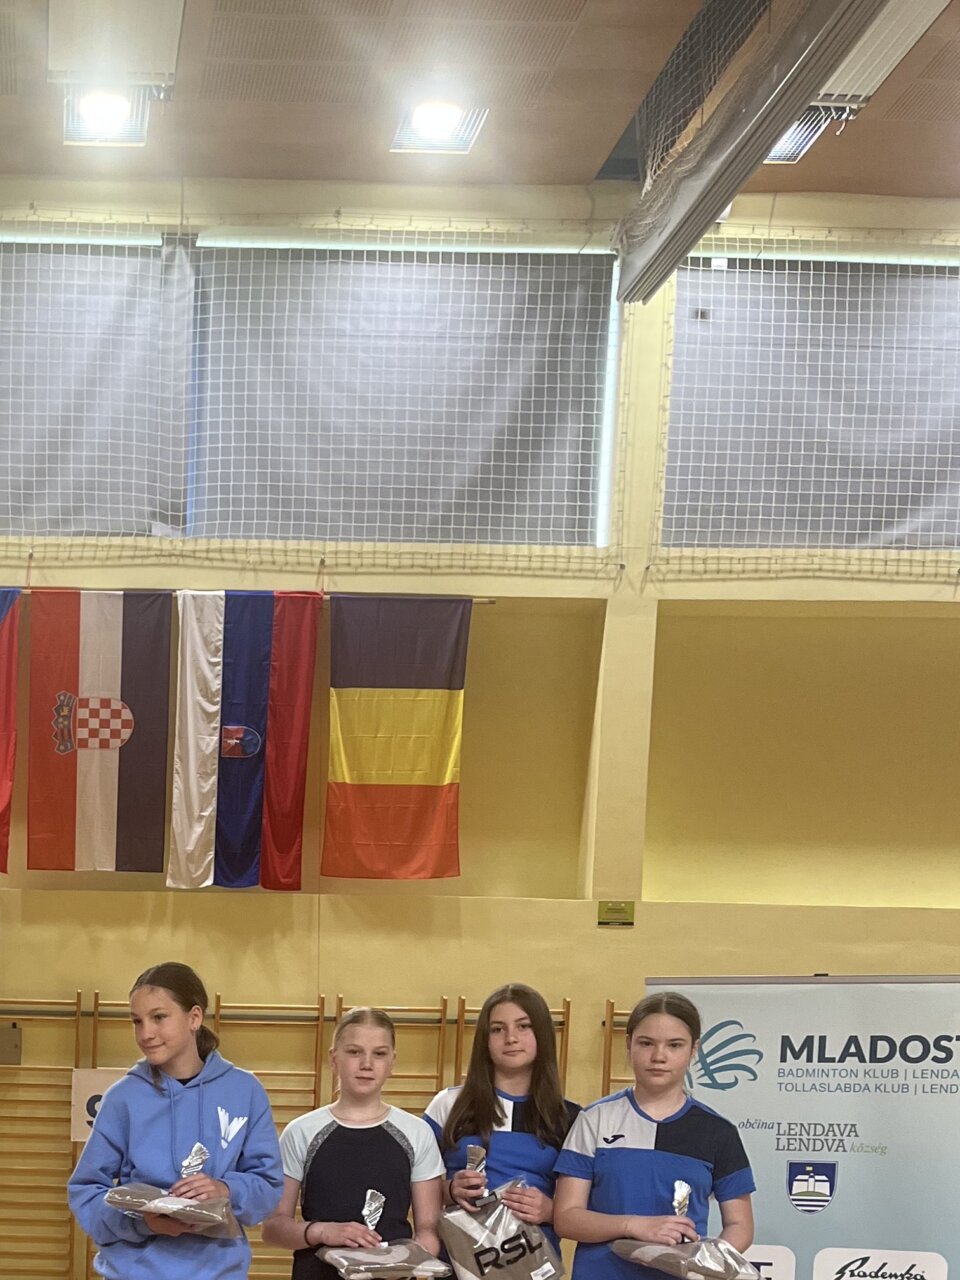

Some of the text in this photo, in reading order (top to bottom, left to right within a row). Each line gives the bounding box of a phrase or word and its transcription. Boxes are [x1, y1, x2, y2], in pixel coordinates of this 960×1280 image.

[779, 1035, 960, 1064] MLADOS
[777, 1068, 859, 1079] BADMINTON
[863, 1069, 899, 1079] KLUB
[778, 1082, 960, 1094] TOLLASLABDA KLUB LEND
[738, 1119, 860, 1138] občina LENDAVA
[775, 1138, 847, 1153] LENDVA
[474, 1231, 542, 1276] RSL
